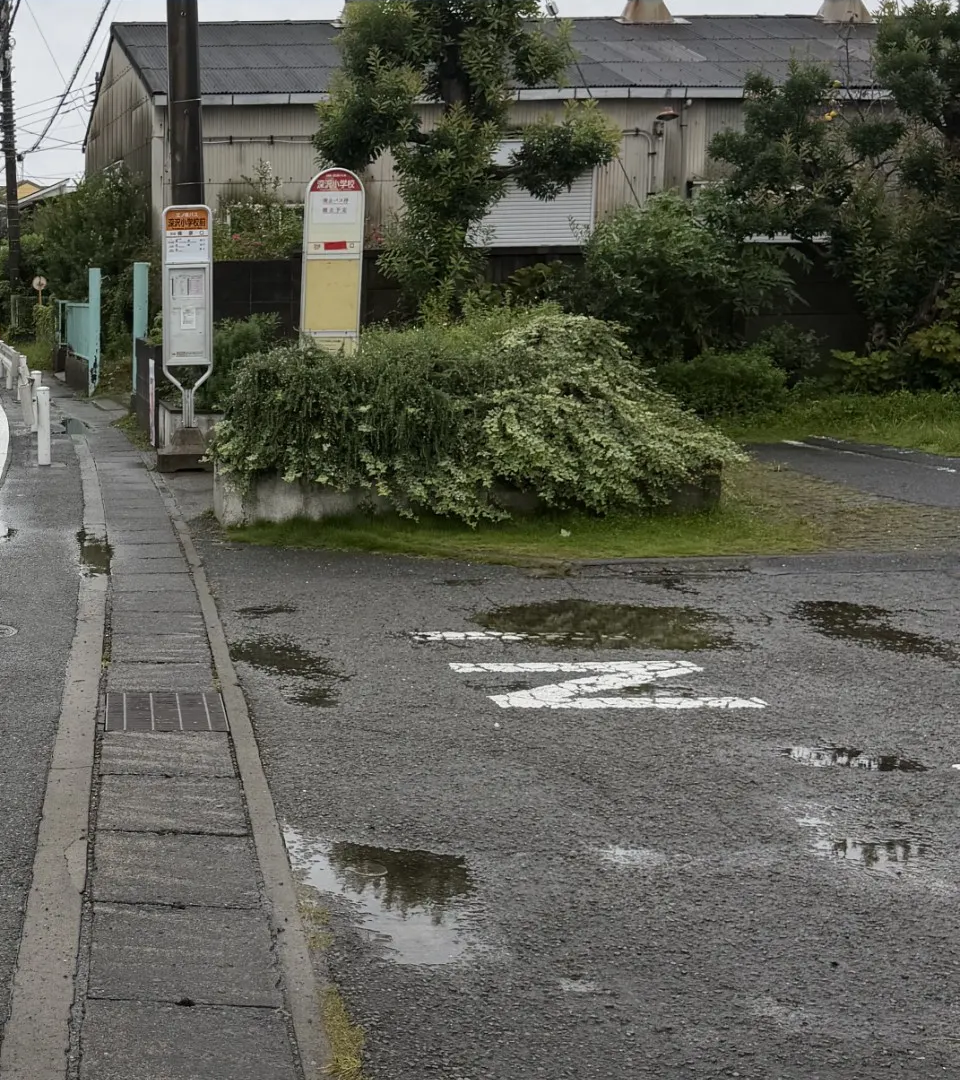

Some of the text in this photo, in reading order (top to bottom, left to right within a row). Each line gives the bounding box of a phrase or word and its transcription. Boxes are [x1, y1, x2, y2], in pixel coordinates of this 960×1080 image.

[316, 179, 356, 189] 深沢小学校
